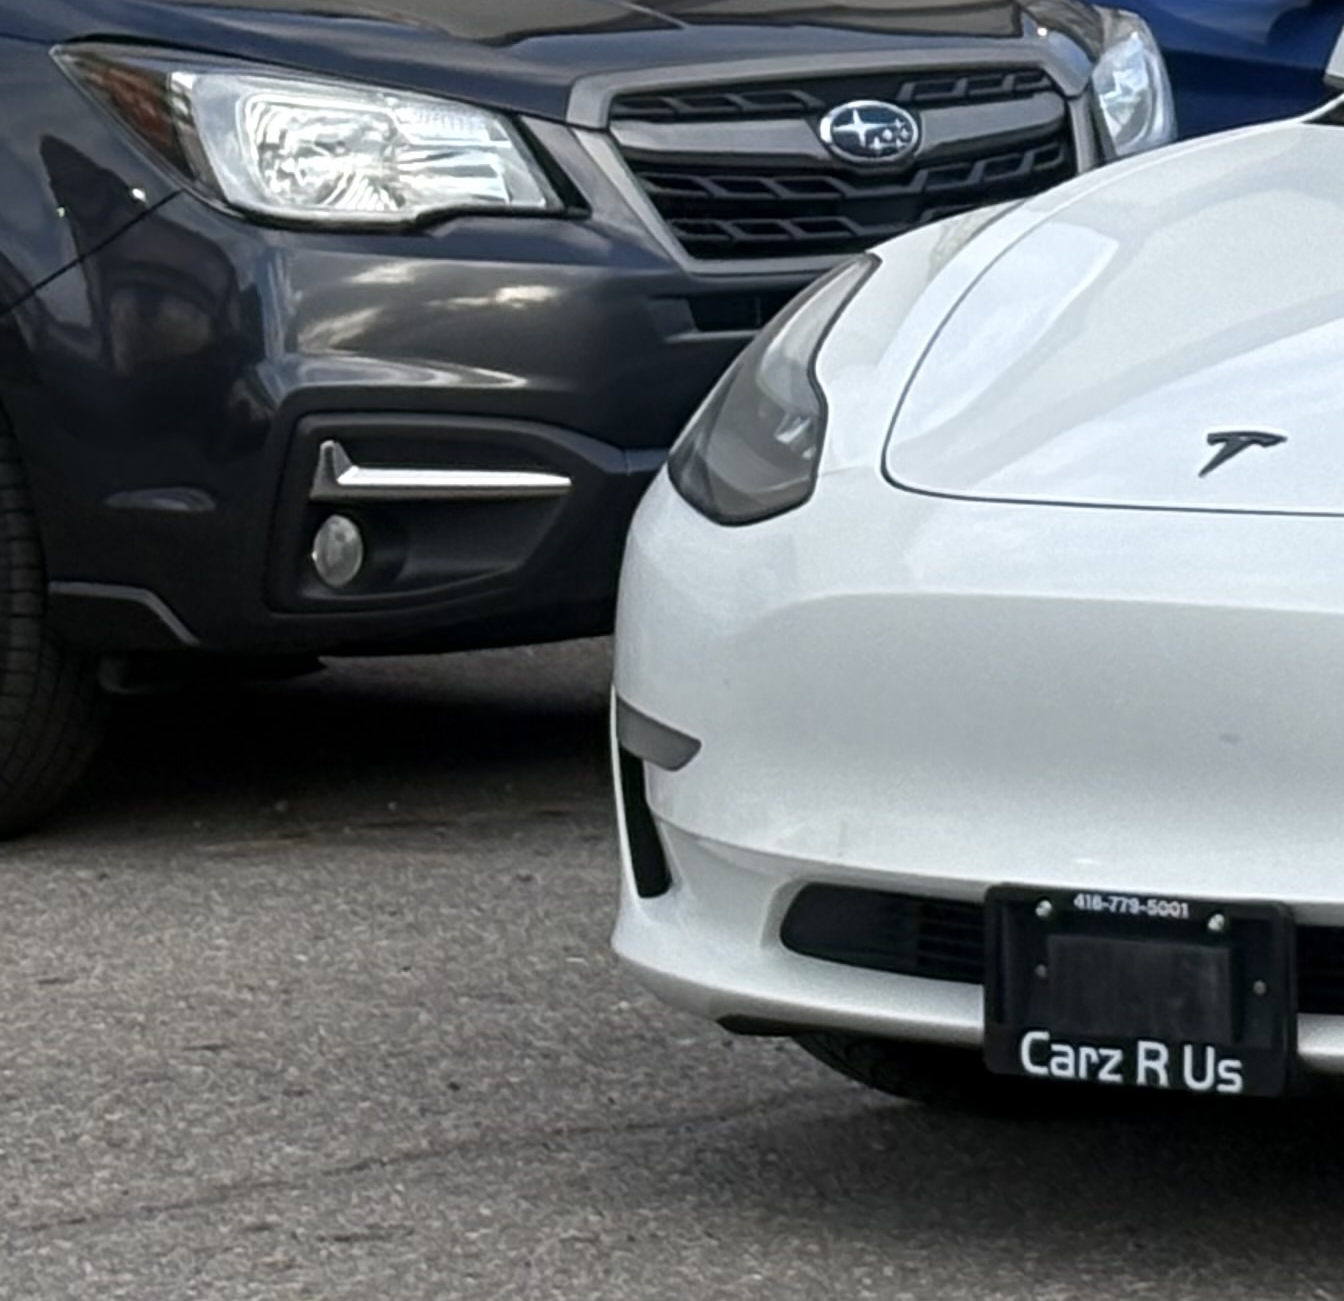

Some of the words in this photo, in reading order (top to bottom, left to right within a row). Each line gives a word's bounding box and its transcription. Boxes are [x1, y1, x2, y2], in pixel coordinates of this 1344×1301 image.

[1074, 892, 1188, 918] 416-779-5001
[1021, 1031, 1123, 1083] Carz
[1136, 1040, 1169, 1088] R
[1184, 1044, 1243, 1093] Us
